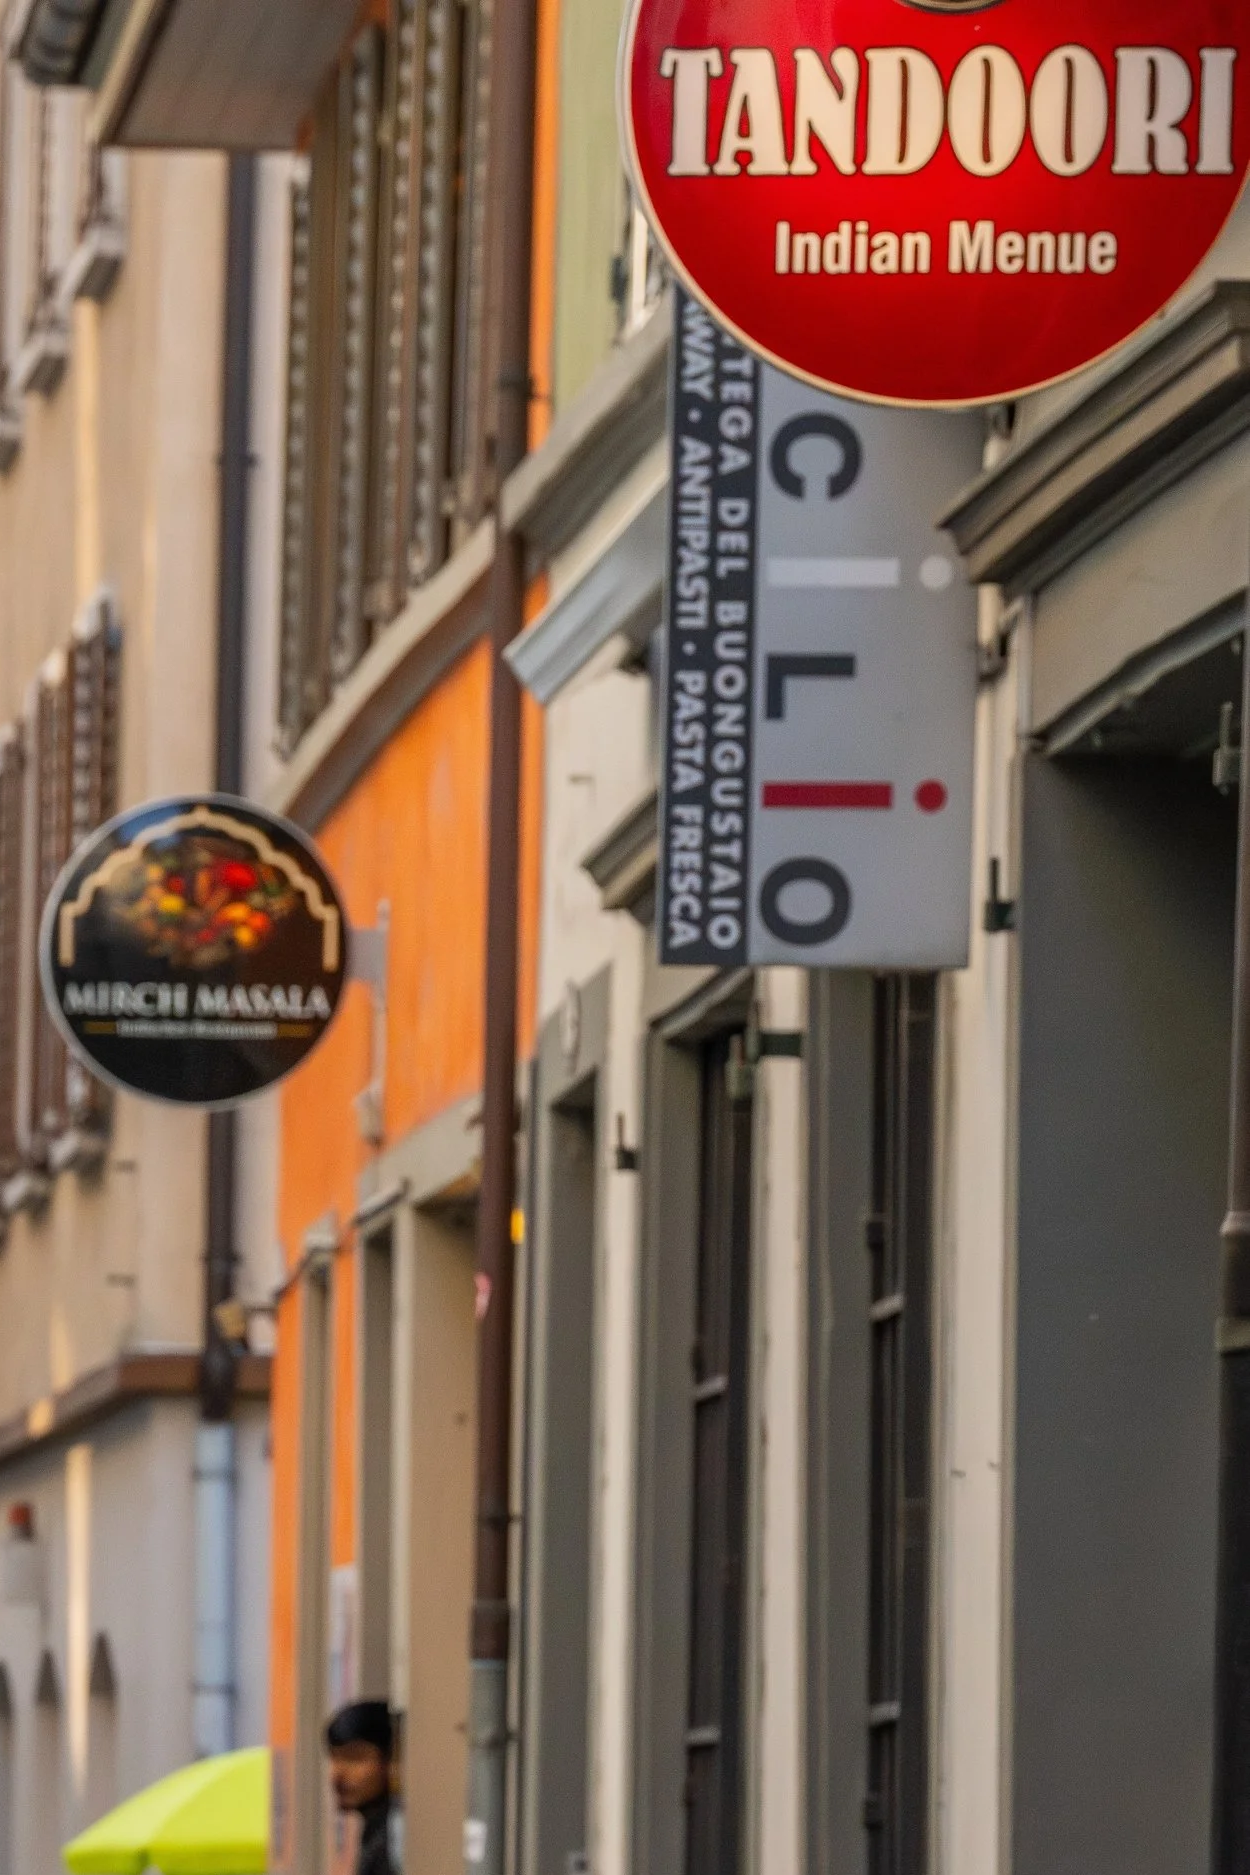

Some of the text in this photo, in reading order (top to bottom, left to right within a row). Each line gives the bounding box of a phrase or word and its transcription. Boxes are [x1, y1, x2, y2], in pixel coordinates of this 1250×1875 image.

[660, 44, 1236, 177] TANDOORI
[775, 220, 1118, 274] Indian Menue
[675, 433, 712, 631] ANTIPASTI
[714, 496, 750, 579] DEL
[671, 669, 707, 793] PASTA
[706, 600, 749, 950] BUONGUSTAIO
[668, 804, 704, 949] FRESCA
[64, 981, 332, 1020] MIRCH MASALA
